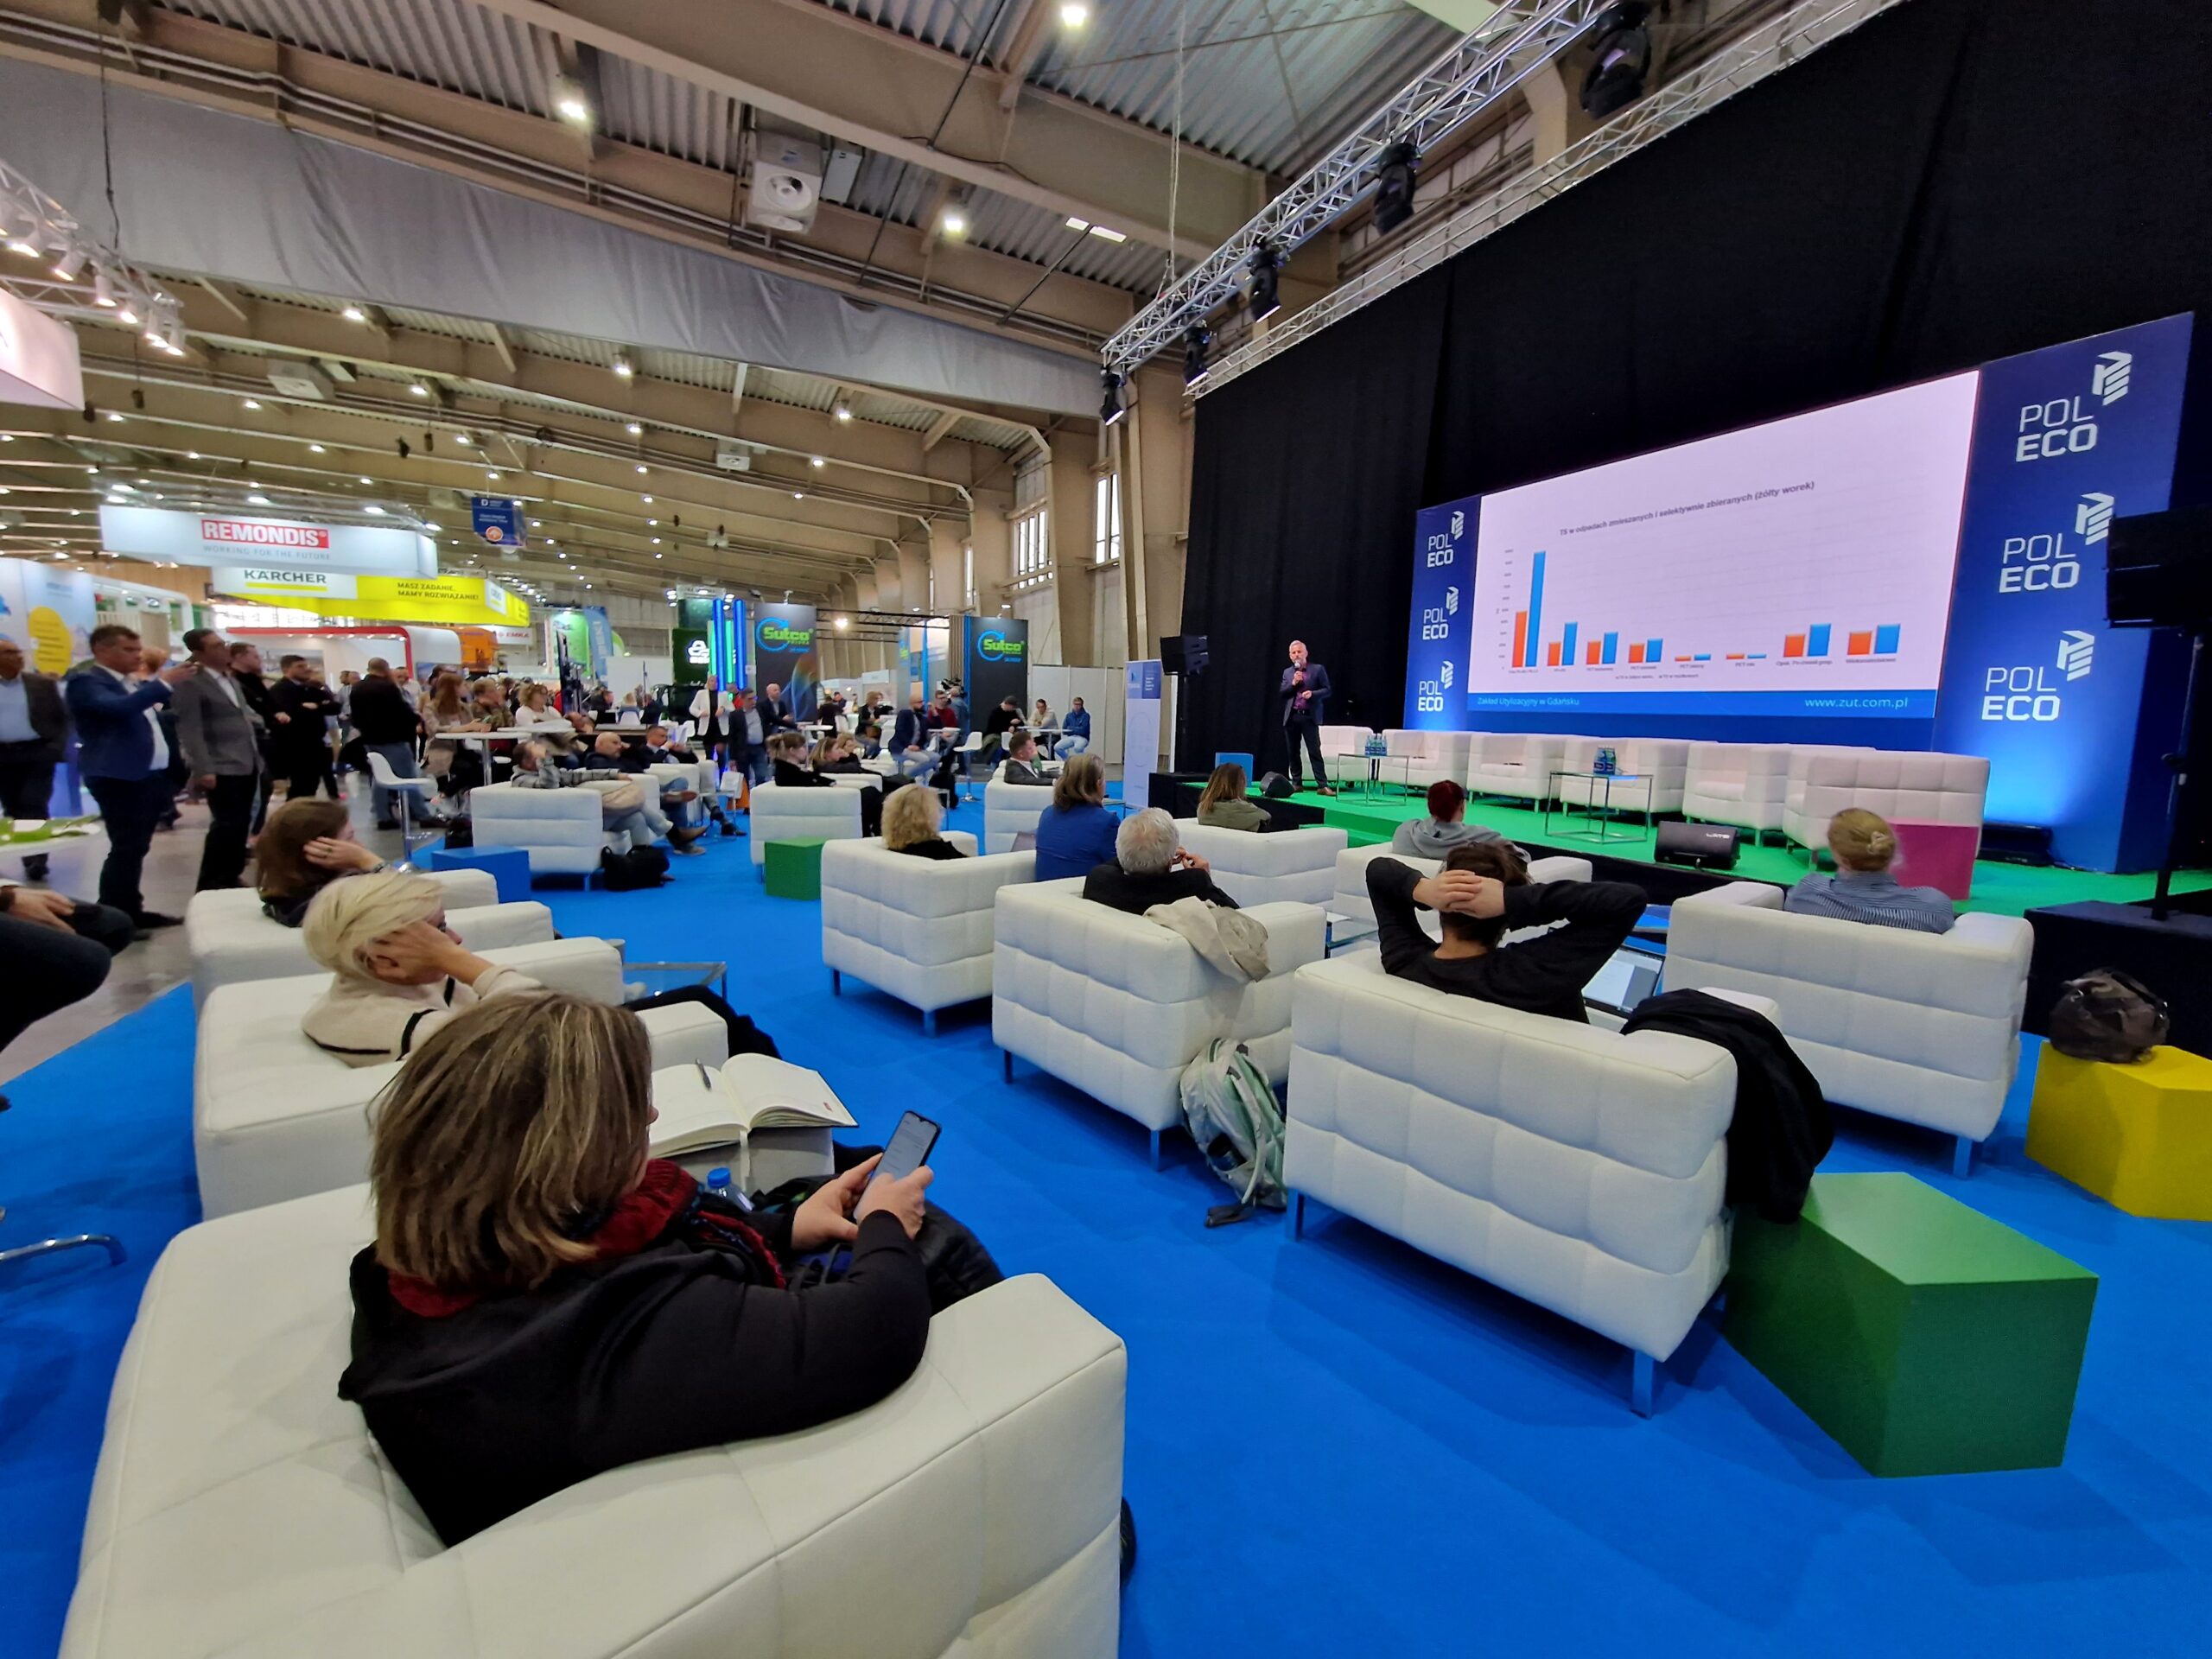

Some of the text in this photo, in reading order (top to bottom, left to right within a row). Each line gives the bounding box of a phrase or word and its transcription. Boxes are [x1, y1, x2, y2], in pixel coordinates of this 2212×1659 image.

[2019, 395, 2094, 433] POL
[2016, 423, 2098, 462] ECO
[1560, 527, 1568, 537] TS
[1576, 521, 1607, 534] odpadach
[1609, 512, 1654, 527] zmieszanych
[1659, 501, 1705, 518] selektywnie
[1707, 493, 1752, 509] zbieranych
[1754, 486, 1780, 501] (żółty
[1782, 480, 1815, 494] worek)
[1428, 533, 1453, 551] POL
[2003, 532, 2077, 565] POL
[202, 544, 330, 561] WORKING FOR THE FUTURE
[1427, 549, 1454, 568] ECO
[244, 569, 327, 584] KÄRCHER
[1999, 561, 2081, 594] ECO
[424, 591, 480, 601] ROZWIĄZANIE!
[1423, 607, 1447, 623] POL
[763, 626, 810, 641] Sutco
[1422, 623, 1449, 640] ECO
[983, 639, 1023, 652] Sutco
[1418, 680, 1442, 696] POL
[1985, 665, 2057, 694] POL
[1418, 696, 1445, 712] ECO
[1499, 698, 1538, 707] Utylizacyjny
[1547, 696, 1580, 706] Gdańsku
[1804, 696, 1909, 710] www.zut.com.pl
[1980, 695, 2061, 722] ECO
